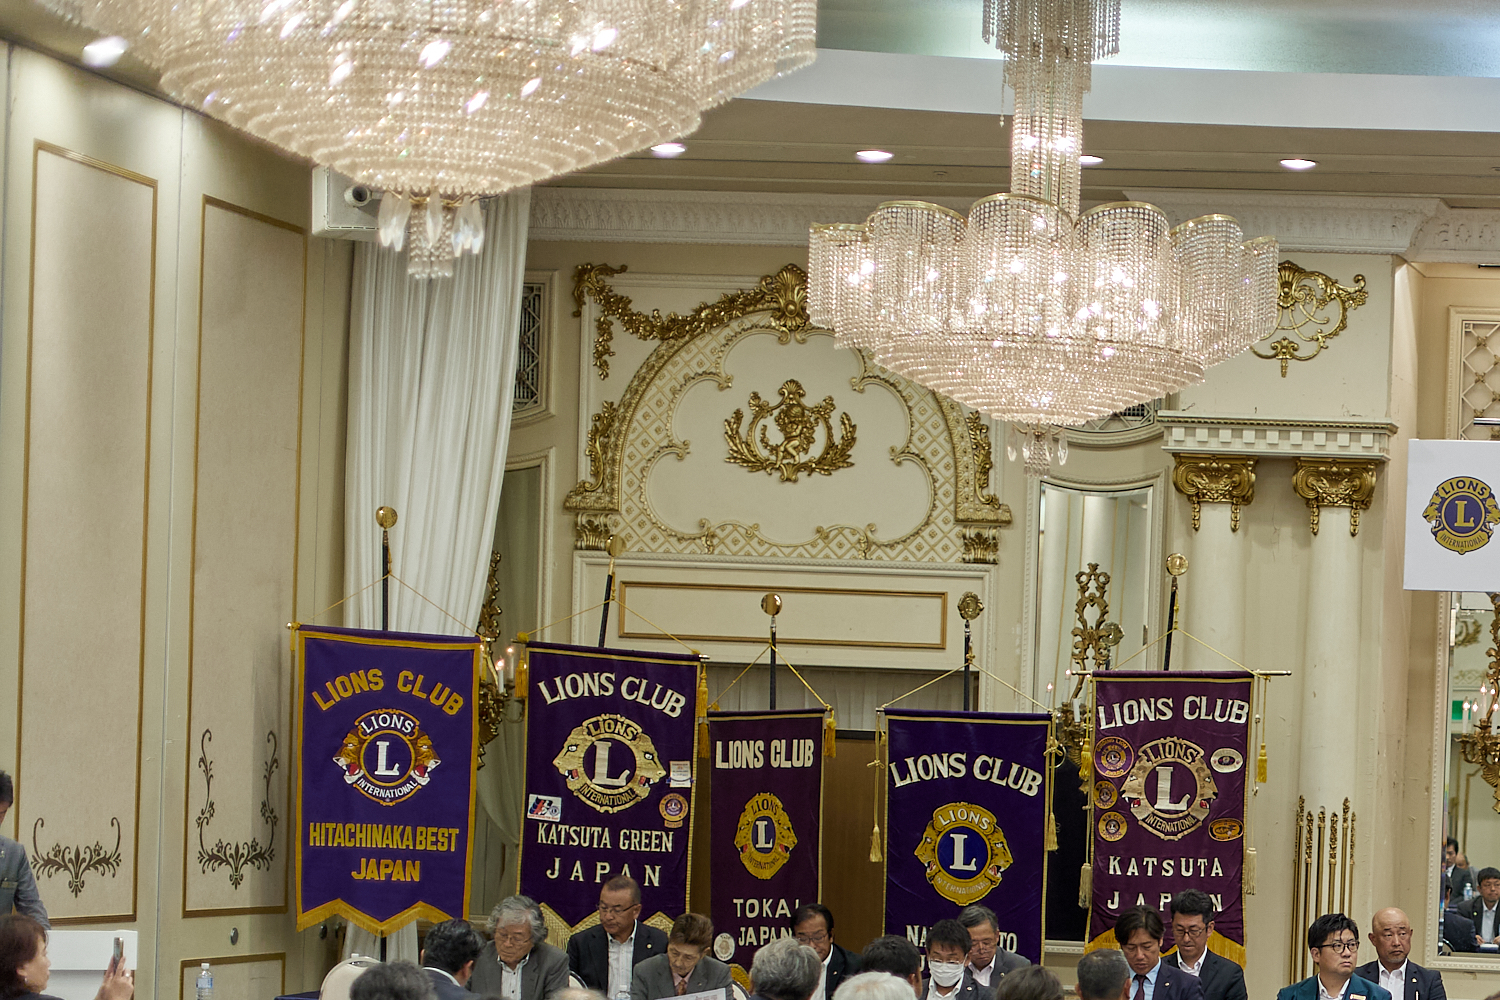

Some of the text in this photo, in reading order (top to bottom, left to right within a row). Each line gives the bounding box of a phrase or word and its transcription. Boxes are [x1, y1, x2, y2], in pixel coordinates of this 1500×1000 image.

[1441, 478, 1489, 498] LIONS
[1454, 501, 1475, 528] L
[1439, 532, 1487, 549] INTERNATIONAL
[312, 669, 464, 715] LIONS CLUB
[537, 672, 686, 718] LIONS CLUB
[361, 714, 414, 733] LIONS
[1098, 696, 1249, 730] LIONS CLUB
[588, 720, 637, 741] LIONS
[375, 741, 399, 775] L
[592, 741, 630, 786] L
[715, 739, 814, 769] LIONS CLUB
[1146, 741, 1198, 764] LIONS
[889, 753, 1043, 797] LIONS CLUB
[357, 778, 417, 798] INTERNATIONAL
[579, 784, 635, 805] INTERNATIONAL
[1154, 766, 1190, 811] L
[751, 798, 779, 817] LIONS
[937, 808, 990, 830] LIONS
[755, 820, 773, 849] L
[1145, 813, 1197, 833] INTERNATIONAL
[309, 822, 459, 852] HITACHINAKA BEST
[537, 823, 674, 852] KATSUTA GREEN
[747, 855, 780, 870] INTERNATIONAL
[950, 834, 977, 871] L
[352, 858, 420, 881] JAPAN
[1108, 855, 1224, 877] KATSUTA
[936, 875, 990, 895] INTERNATIONAL
